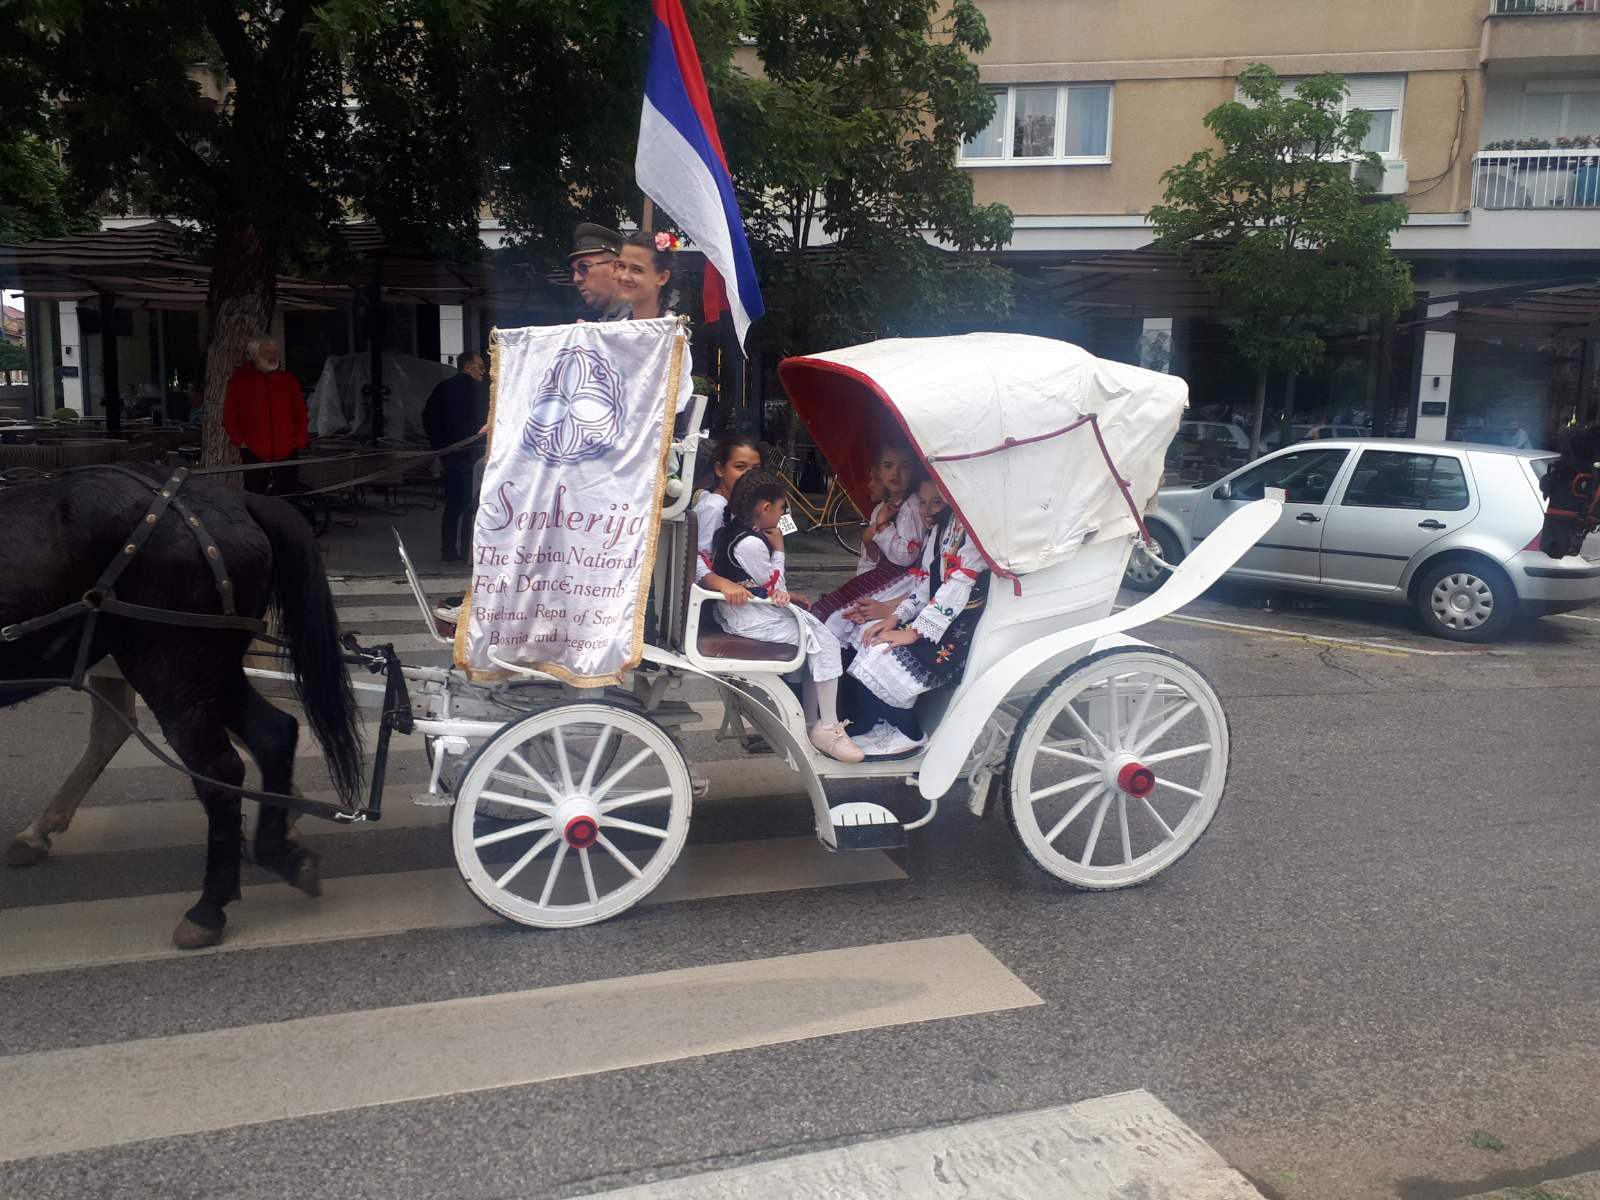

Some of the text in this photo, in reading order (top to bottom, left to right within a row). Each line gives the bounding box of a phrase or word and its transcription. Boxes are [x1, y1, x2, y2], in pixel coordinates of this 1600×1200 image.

[477, 546, 509, 566] The
[566, 546, 639, 569] National
[515, 574, 567, 594] Dance
[573, 610, 589, 626] of
[489, 631, 529, 646] Bosnia
[534, 629, 558, 643] and
